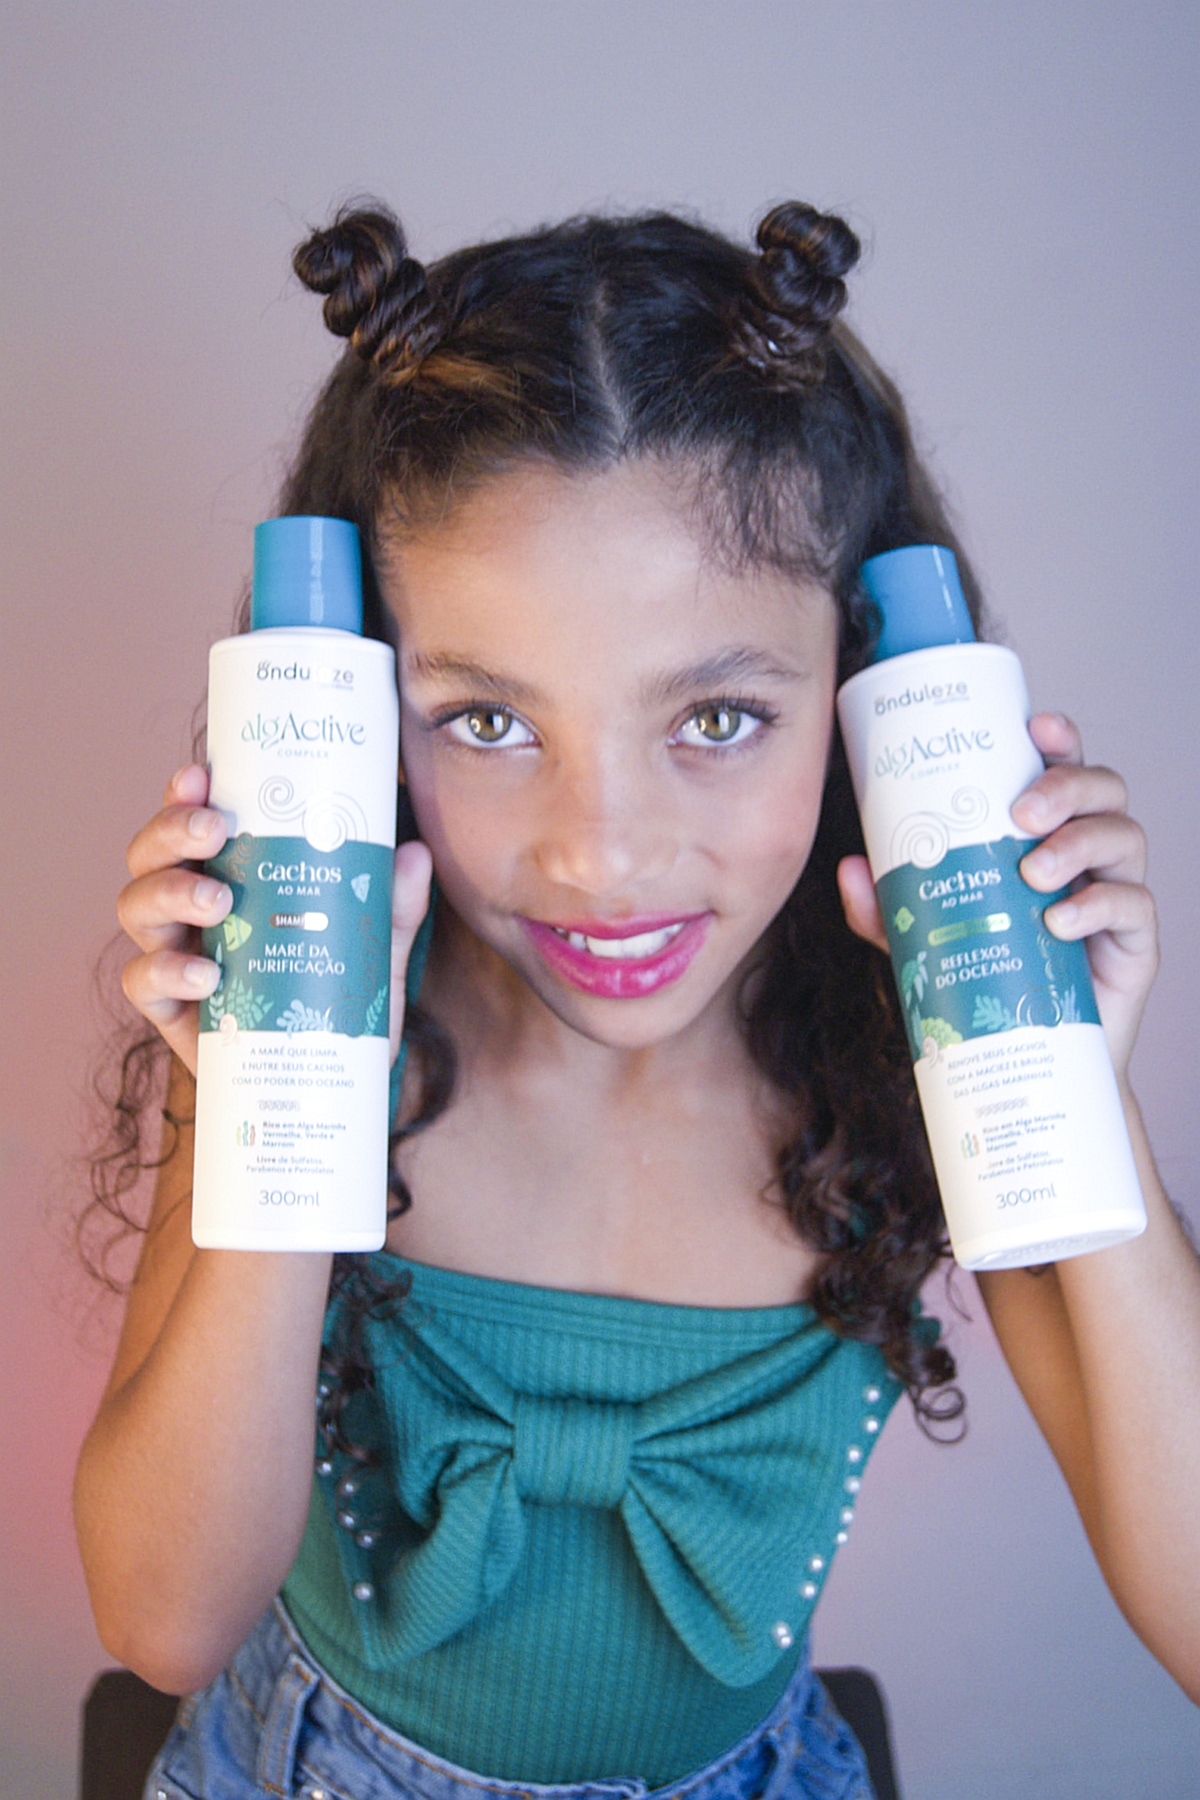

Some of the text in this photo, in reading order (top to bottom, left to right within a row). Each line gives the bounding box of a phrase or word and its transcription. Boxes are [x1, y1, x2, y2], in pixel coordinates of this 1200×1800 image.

[241, 711, 366, 749] algActive
[277, 748, 329, 758] COMPLEX
[874, 727, 994, 779] algActive
[910, 762, 961, 780] COMPLEX
[257, 861, 342, 884] Cachos
[277, 886, 321, 896] AO MAR
[918, 868, 1001, 900] Cachos
[941, 891, 984, 909] AO MAR
[264, 942, 329, 958] MARÉ DA
[940, 943, 1010, 972] REFLEXOS
[248, 959, 345, 977] PURIFICAÇÃO
[935, 957, 1023, 990] DO OCEANO
[250, 1045, 338, 1058] A MARÉ QUE LIMPA
[982, 1047, 1005, 1061] SEUS
[1007, 1039, 1047, 1055] CACHOS
[248, 1062, 279, 1071] NUTRE
[281, 1062, 304, 1072] SEUS
[306, 1063, 345, 1074] CACHOS
[231, 1076, 355, 1089] COM O PODER DO OCEANO
[946, 1073, 966, 1086] COM
[971, 1079, 1000, 1093] ALGAS
[258, 1190, 320, 1207] 300ml
[996, 1183, 1057, 1209] 300ml
